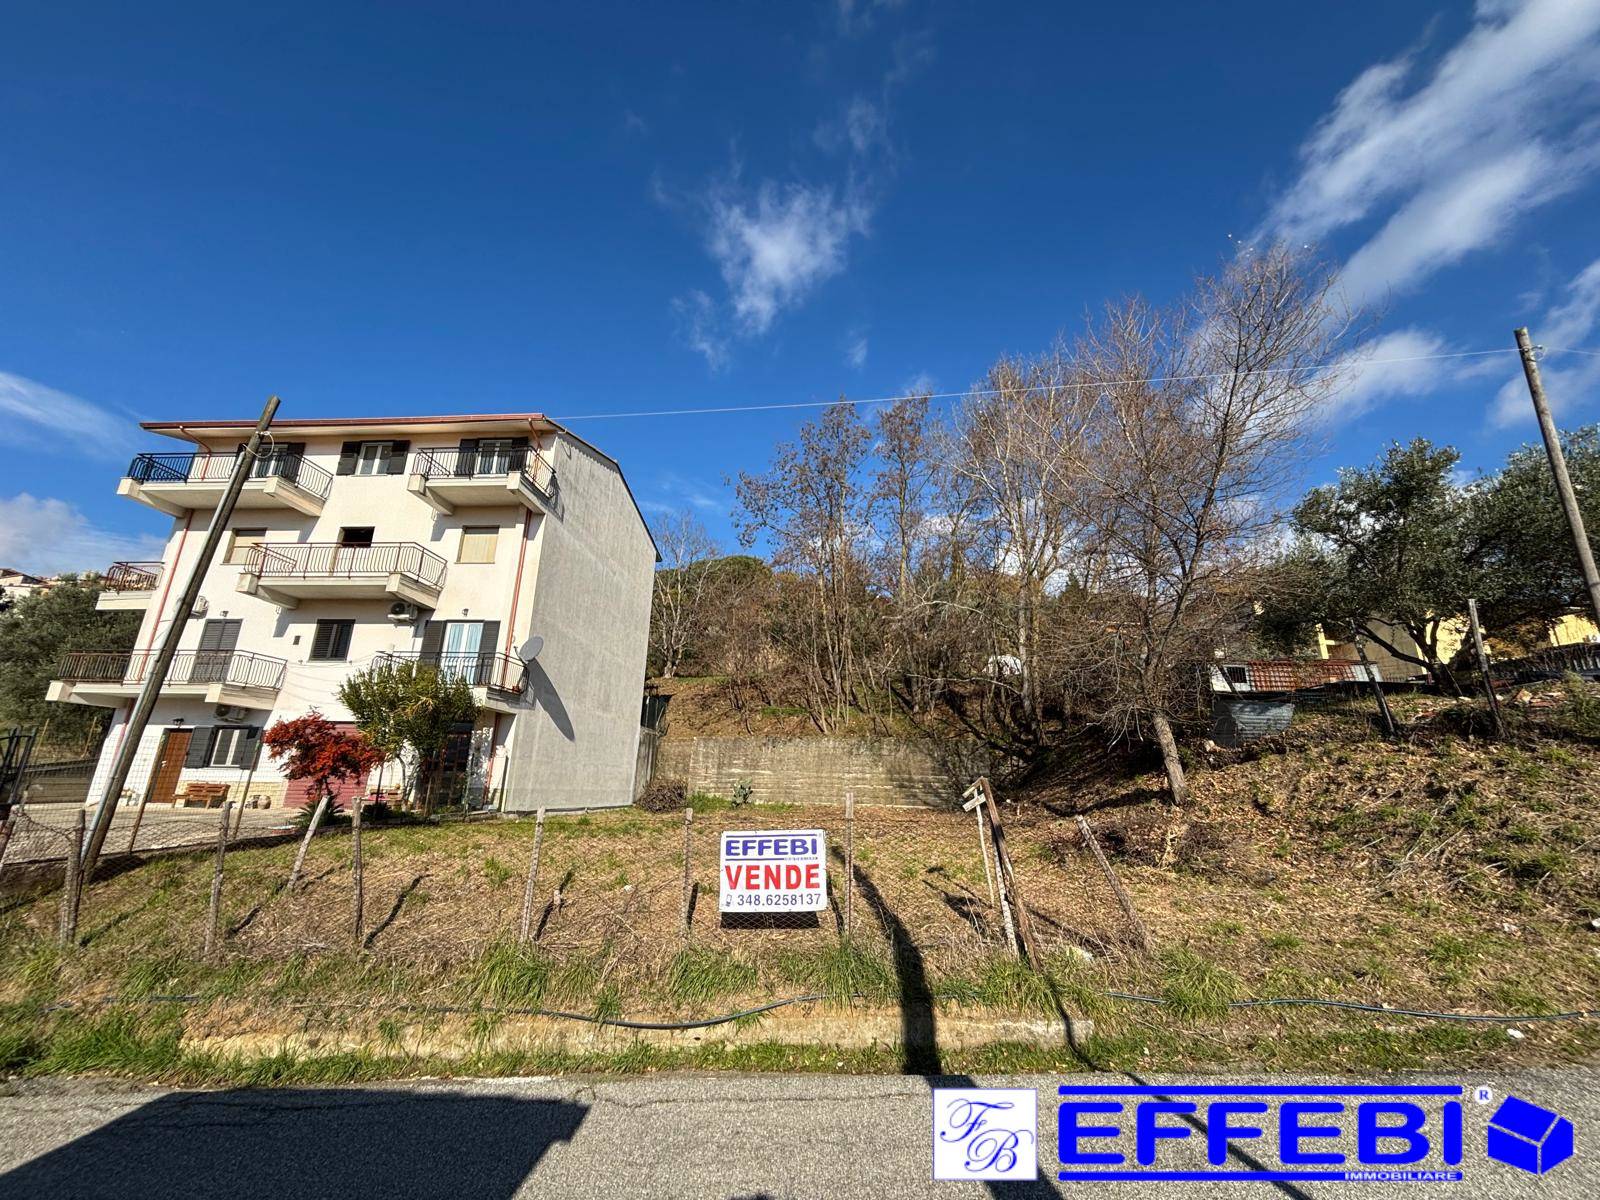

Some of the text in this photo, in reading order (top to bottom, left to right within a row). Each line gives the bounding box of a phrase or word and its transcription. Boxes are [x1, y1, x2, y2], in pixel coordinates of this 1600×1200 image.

[725, 838, 818, 856] EFFEBI
[725, 864, 820, 890] VENDE
[737, 893, 821, 906] 348.6258137
